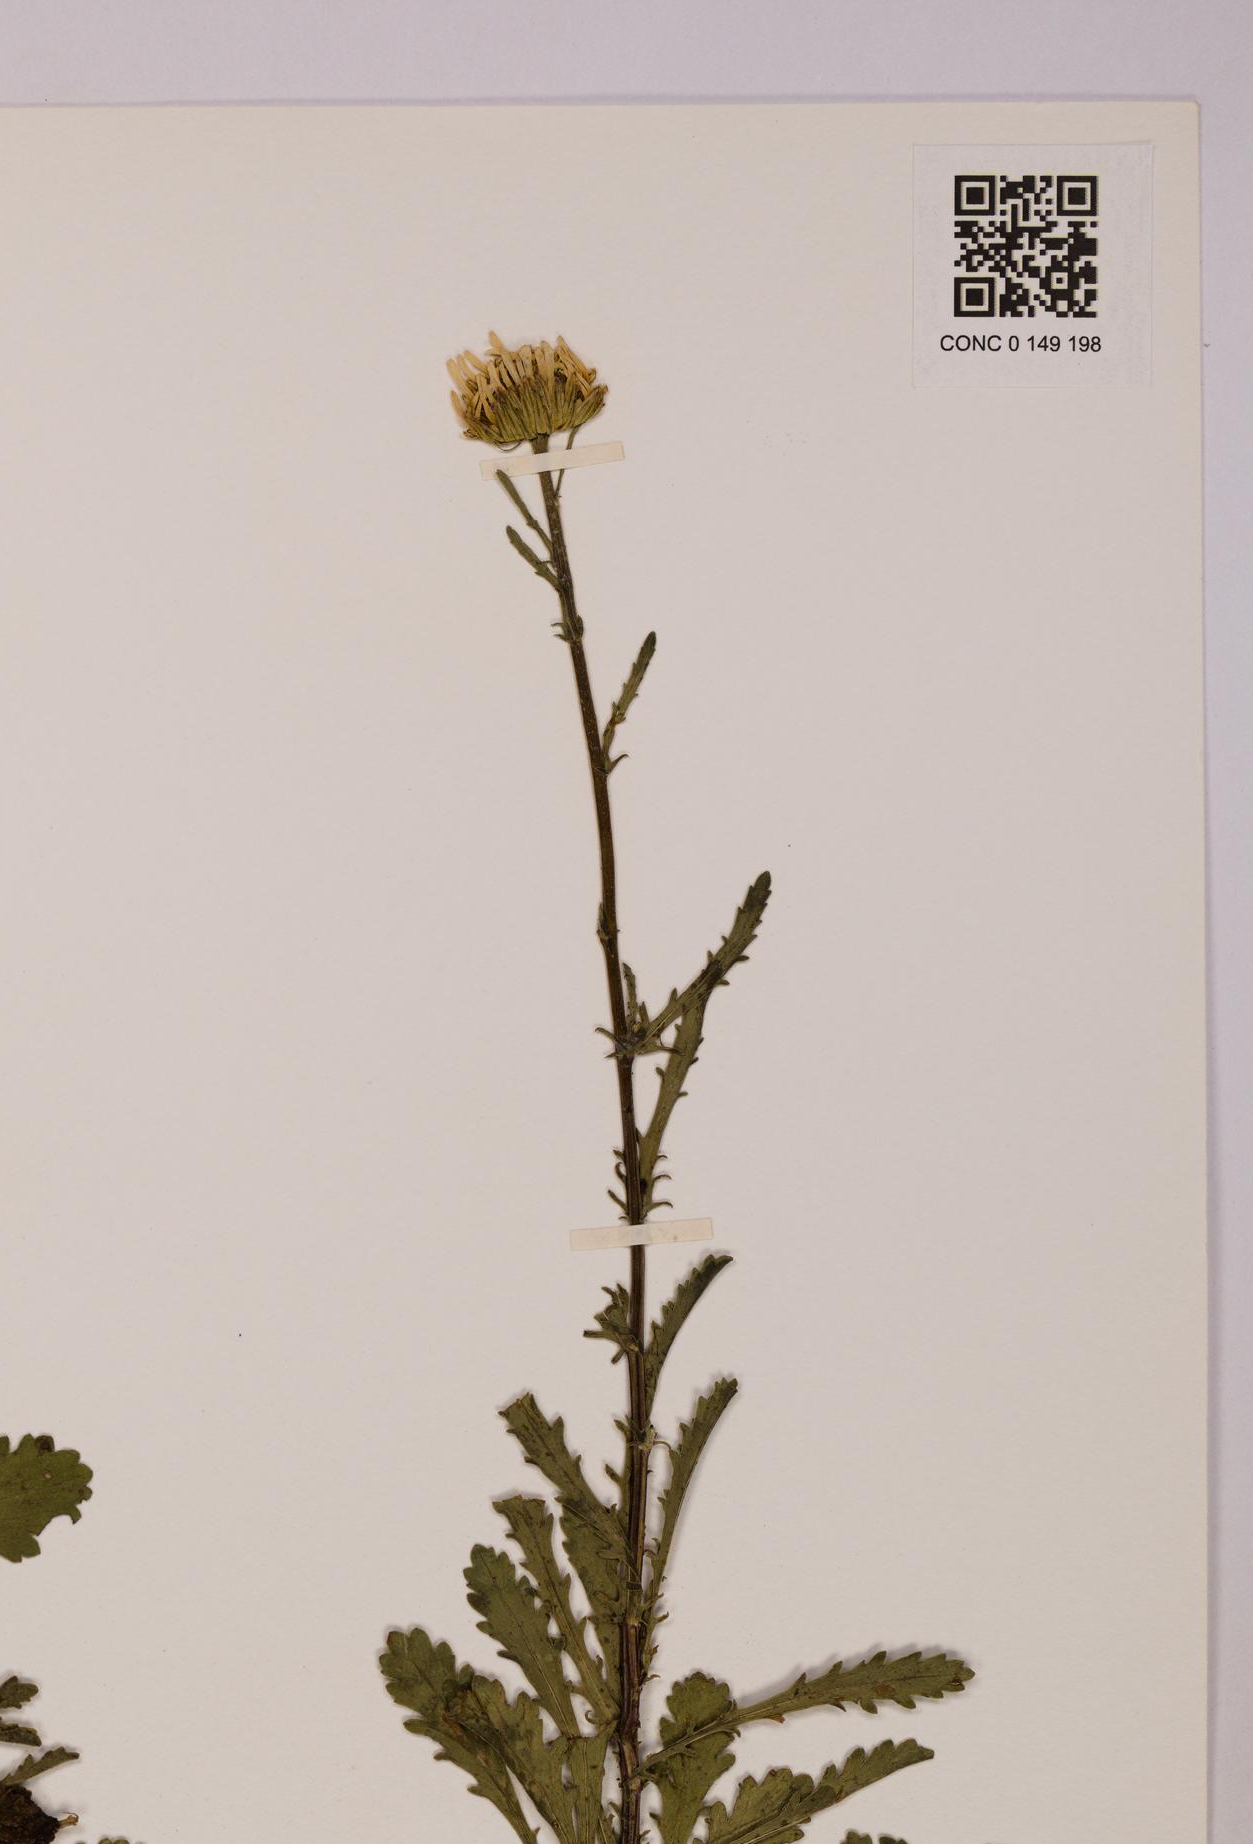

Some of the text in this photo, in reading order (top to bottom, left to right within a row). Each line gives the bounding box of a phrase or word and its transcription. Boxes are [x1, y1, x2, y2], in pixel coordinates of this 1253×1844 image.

[940, 334, 1102, 352] CONC 0 149 198
